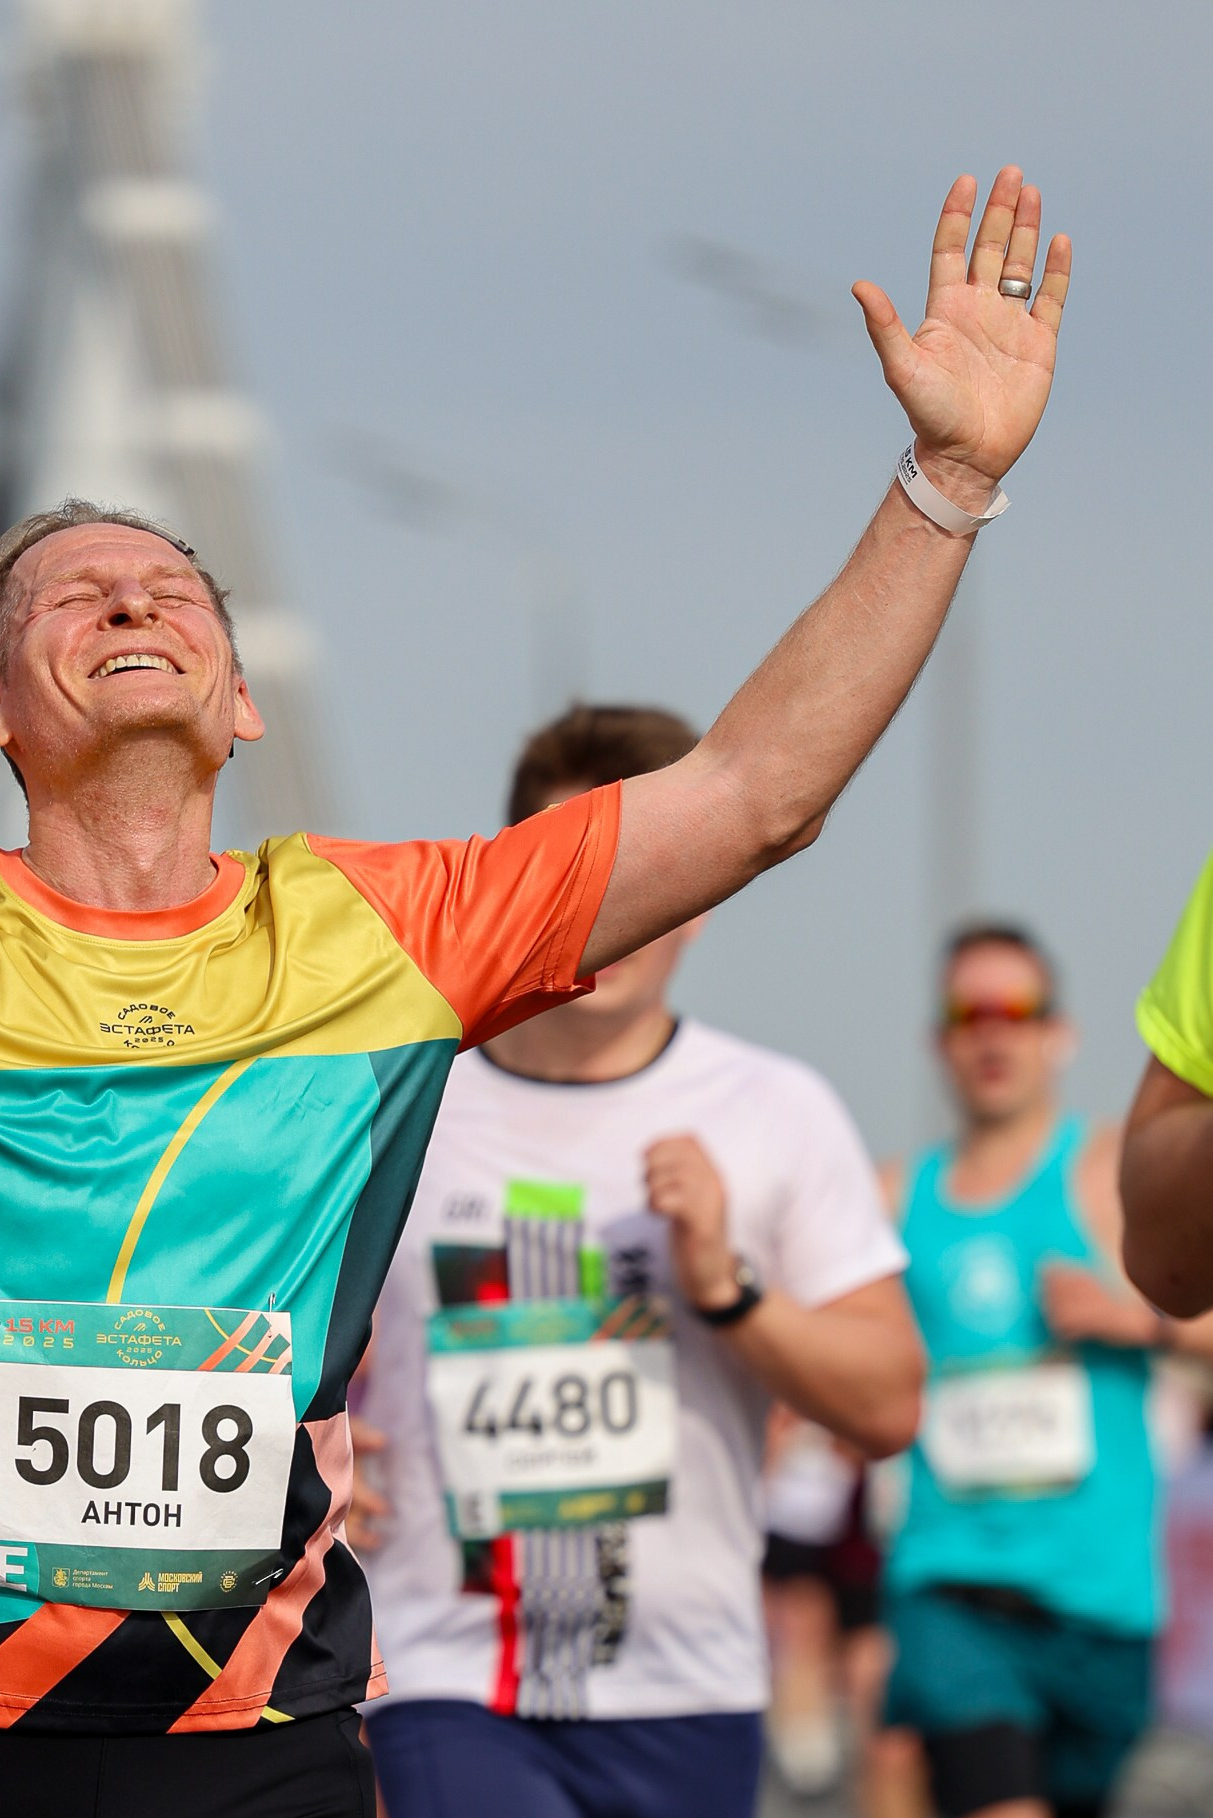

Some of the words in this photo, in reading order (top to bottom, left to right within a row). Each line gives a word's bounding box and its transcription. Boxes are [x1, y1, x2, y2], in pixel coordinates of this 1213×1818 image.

[117, 1003, 176, 1021] САДОВОЕ
[99, 1022, 195, 1035] ЭСТАФЕТА
[5, 1318, 33, 1333] 15
[114, 1309, 166, 1332] САДОВОЕ
[2, 1334, 75, 1349] 2025
[96, 1333, 182, 1347] ЭСТАФЕТА
[116, 1349, 163, 1367] КОЛЬЦО
[464, 1371, 638, 1440] 4480
[14, 1396, 253, 1494] 5018
[80, 1500, 182, 1528] АНТОН
[158, 1571, 203, 1583] МОСКОВСКИЙ
[157, 1583, 180, 1593] СПОРТ
